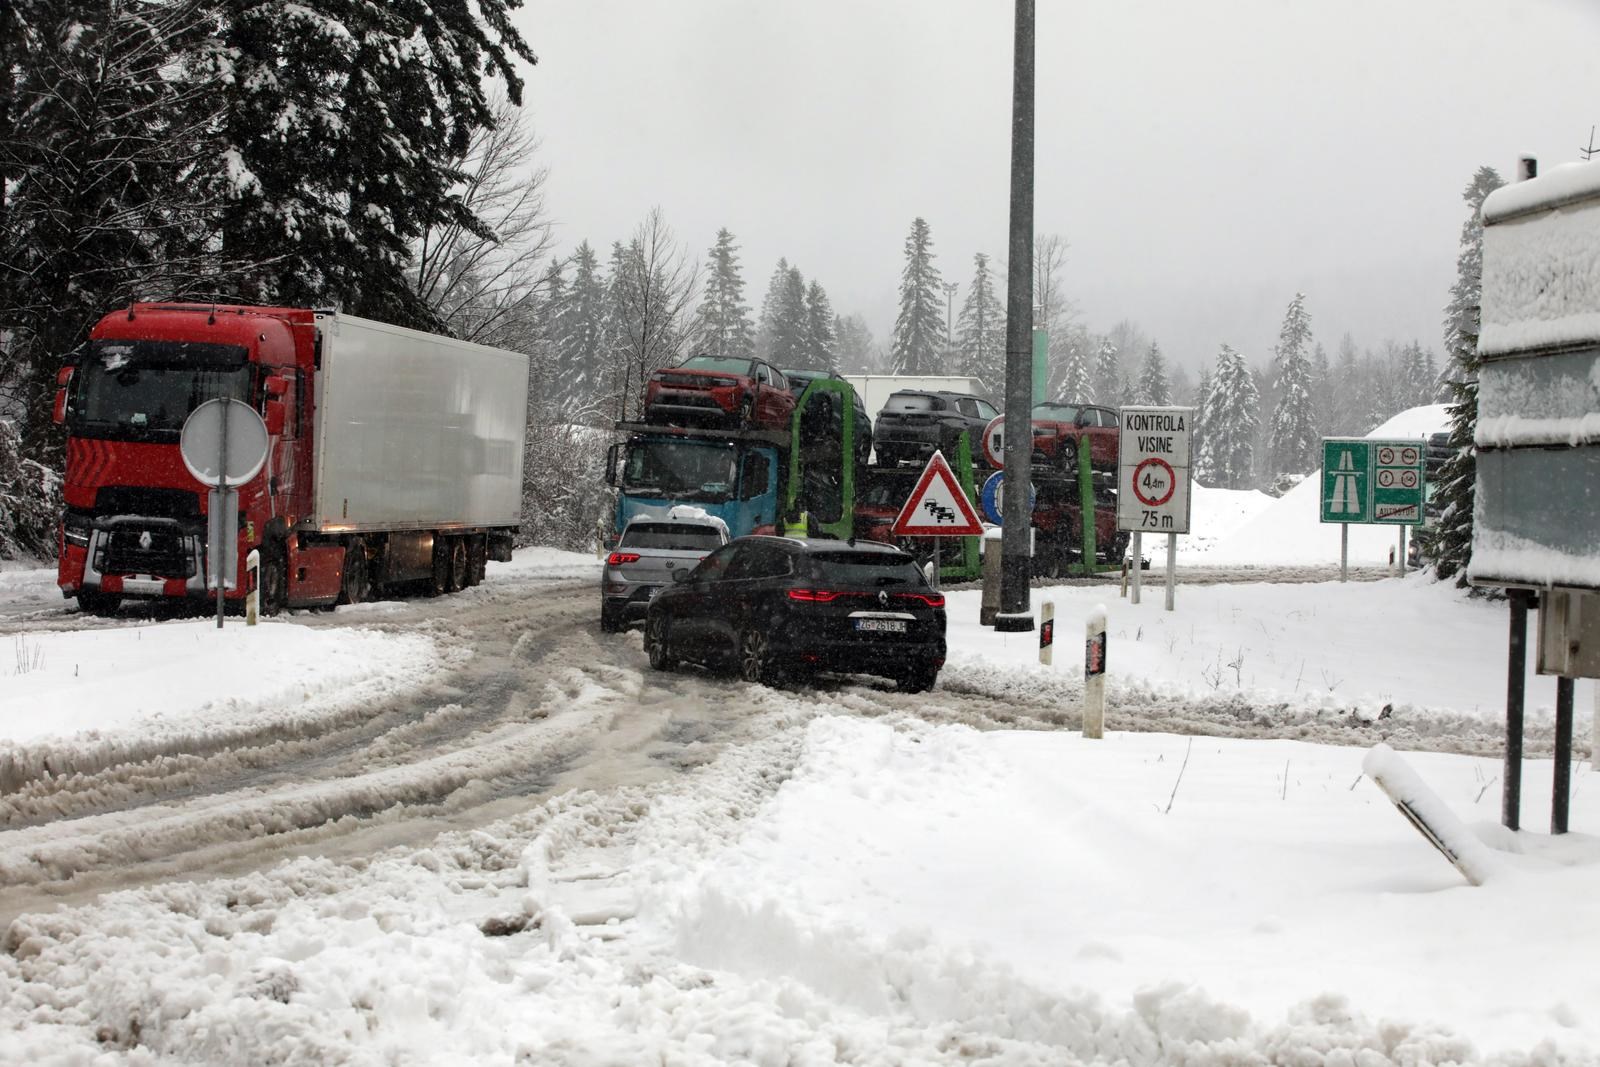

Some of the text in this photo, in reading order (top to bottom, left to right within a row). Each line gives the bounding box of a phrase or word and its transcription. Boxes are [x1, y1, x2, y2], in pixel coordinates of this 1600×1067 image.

[1127, 415, 1185, 431] KONTROLA
[1138, 436, 1173, 453] VISINE
[1142, 511, 1173, 528] 75 m
